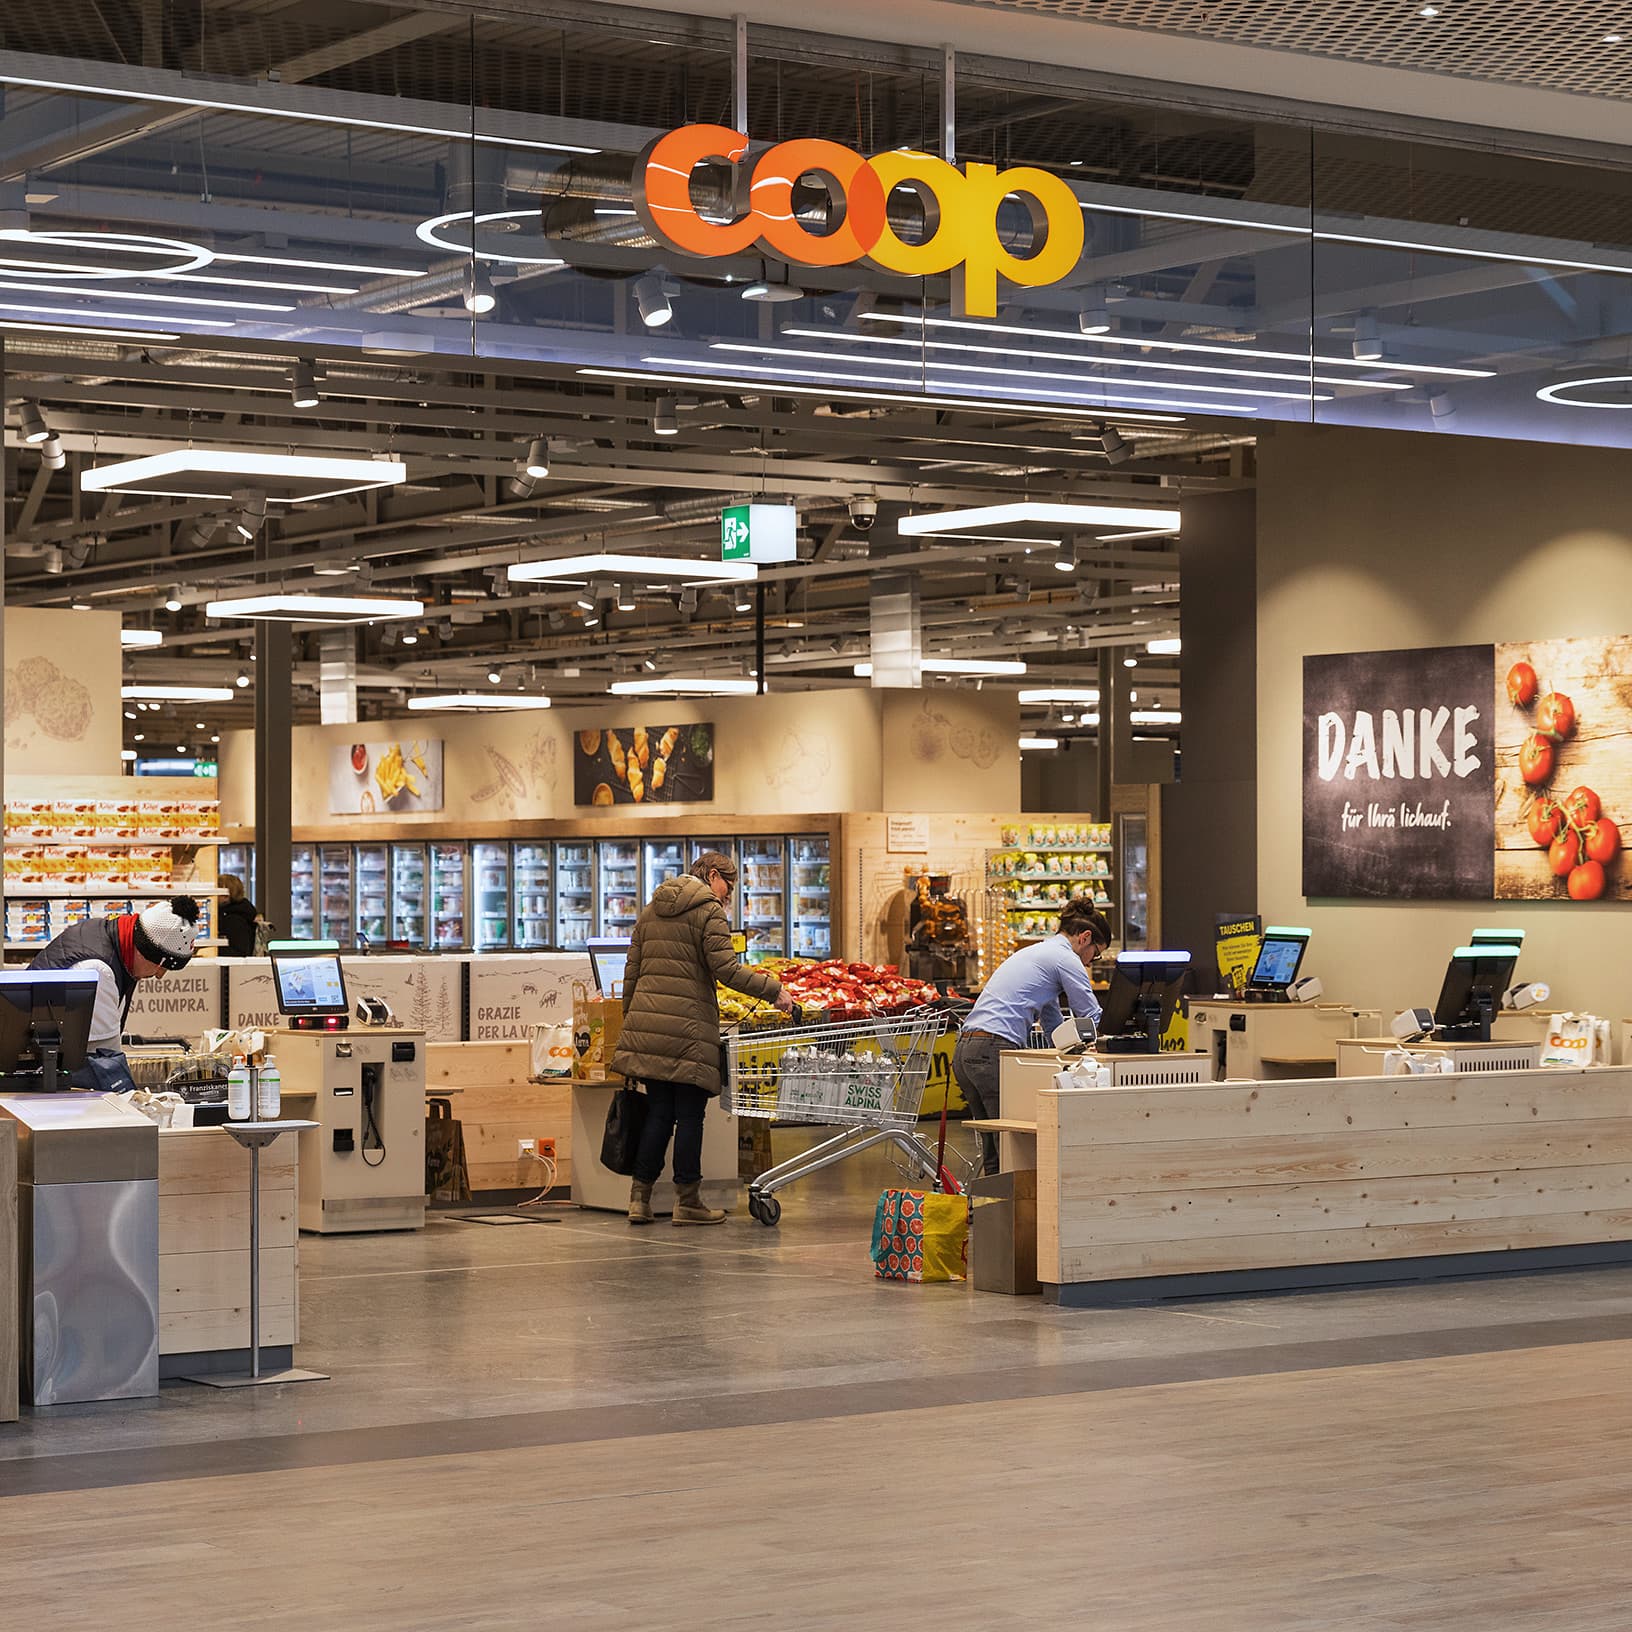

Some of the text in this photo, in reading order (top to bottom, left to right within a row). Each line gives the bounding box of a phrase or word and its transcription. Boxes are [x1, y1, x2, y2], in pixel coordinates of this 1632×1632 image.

[643, 123, 1084, 318] coop
[1317, 704, 1481, 782] DANKE
[1341, 801, 1364, 832] für
[1219, 921, 1255, 936] TAUSCHEN
[137, 978, 209, 993] ENGRAZIEL
[148, 998, 209, 1013] CUMPRA.
[477, 1006, 521, 1020] GRAZIE
[238, 1012, 280, 1027] DANKE
[477, 1025, 499, 1039] PER
[502, 1025, 518, 1038] LA
[847, 1084, 882, 1098] SWISS
[845, 1095, 882, 1110] ALPINA
